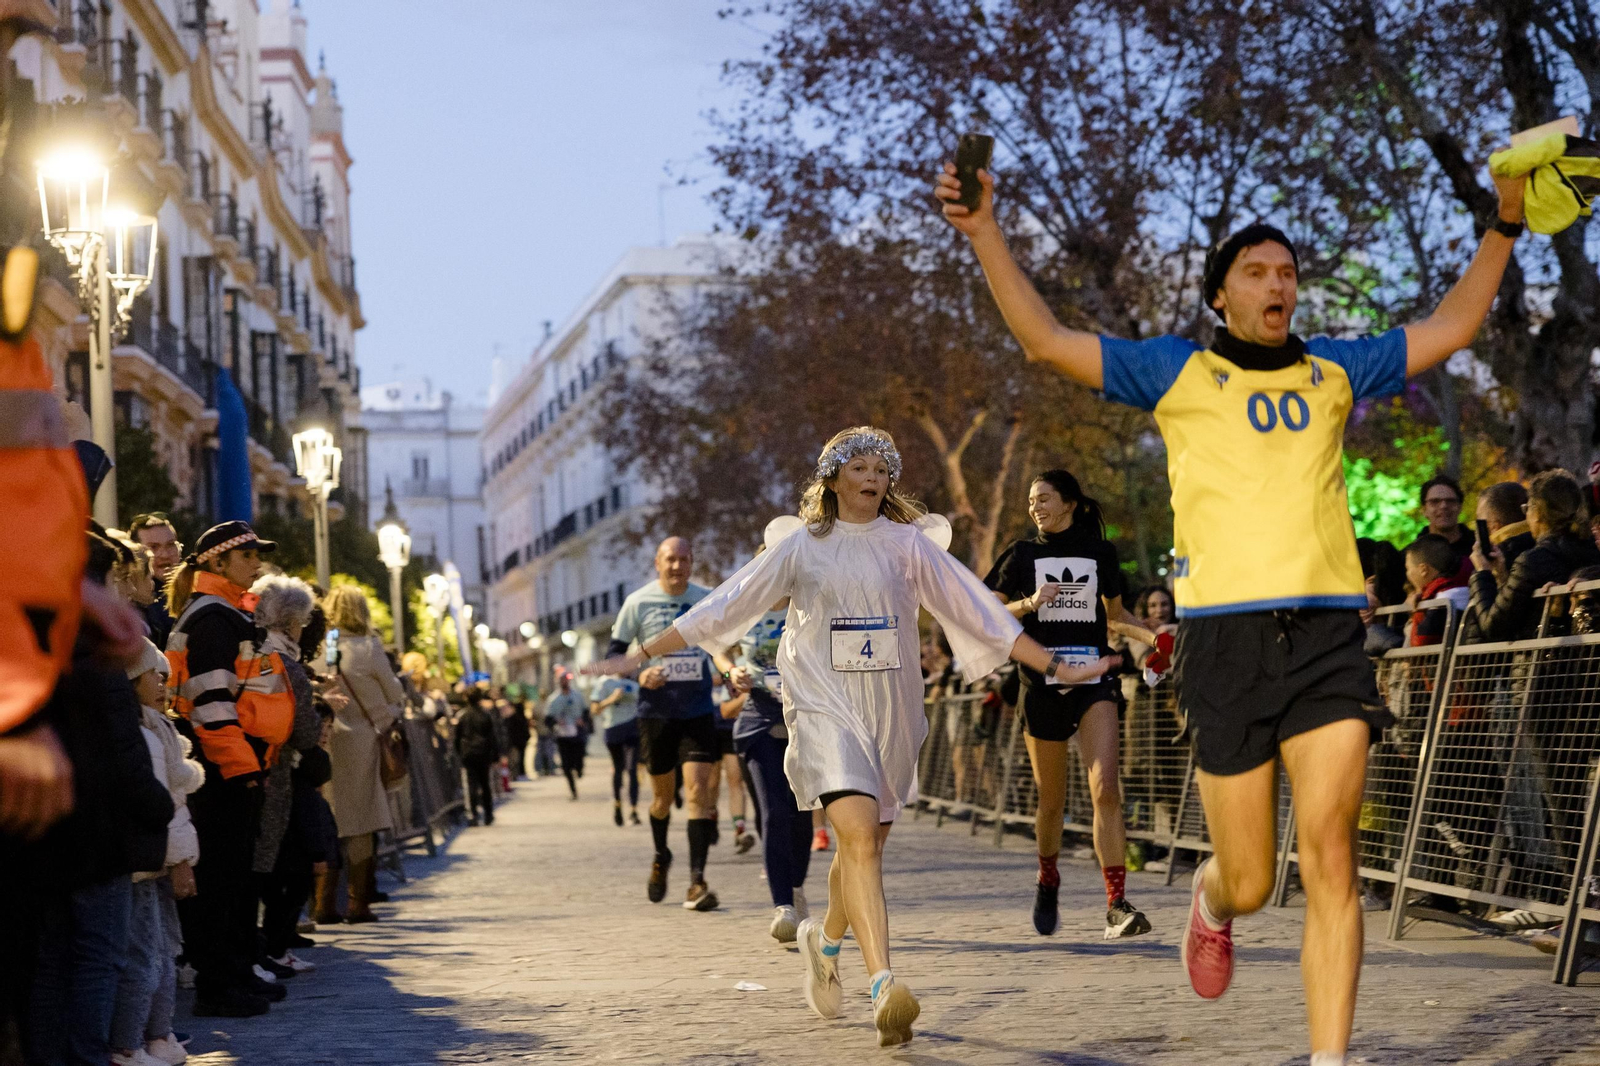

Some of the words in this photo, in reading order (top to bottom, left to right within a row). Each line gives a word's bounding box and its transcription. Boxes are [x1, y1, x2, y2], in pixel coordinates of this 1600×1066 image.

[1247, 391, 1310, 433] 00
[1046, 597, 1088, 609] adidas
[860, 639, 874, 659] 4
[667, 662, 697, 674] 1034
